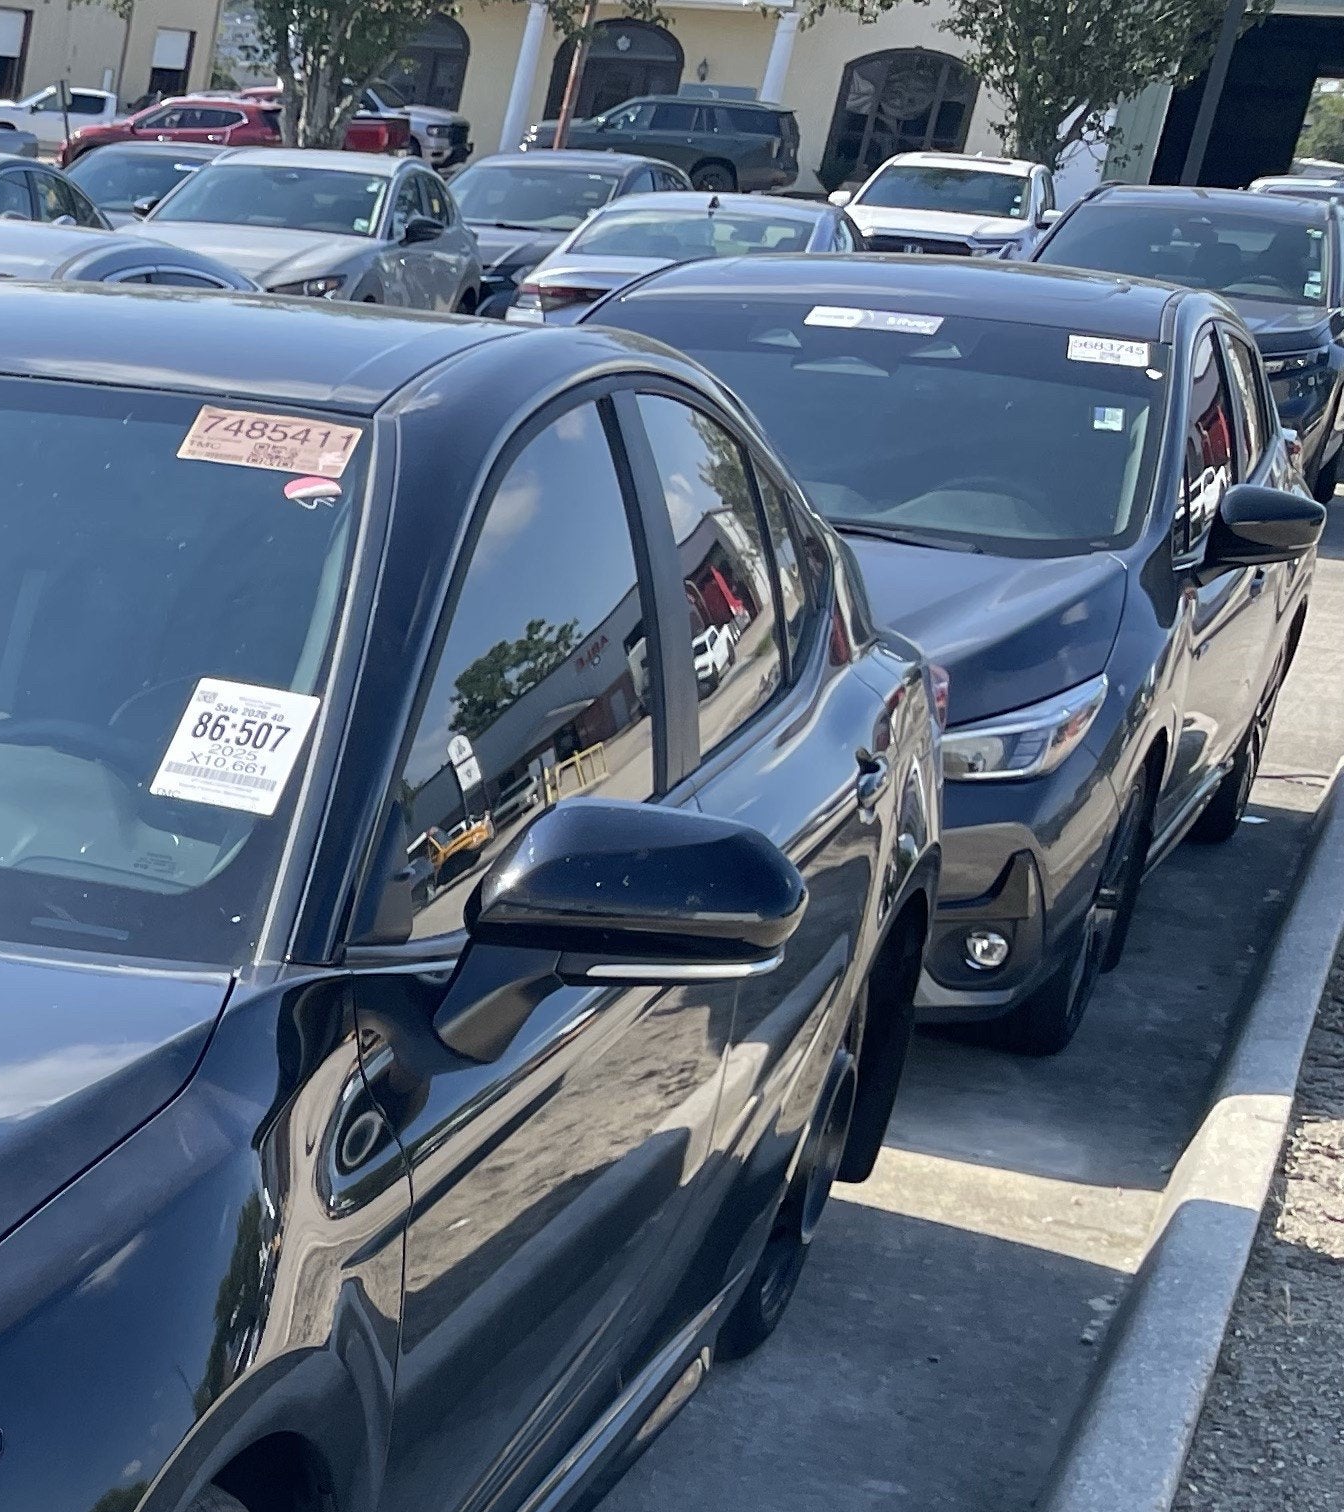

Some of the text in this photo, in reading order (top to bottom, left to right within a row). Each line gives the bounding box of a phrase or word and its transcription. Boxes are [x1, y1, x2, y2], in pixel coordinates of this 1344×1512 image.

[202, 414, 354, 452] 7485411
[191, 711, 291, 752] 86:507
[208, 743, 258, 761] 2025
